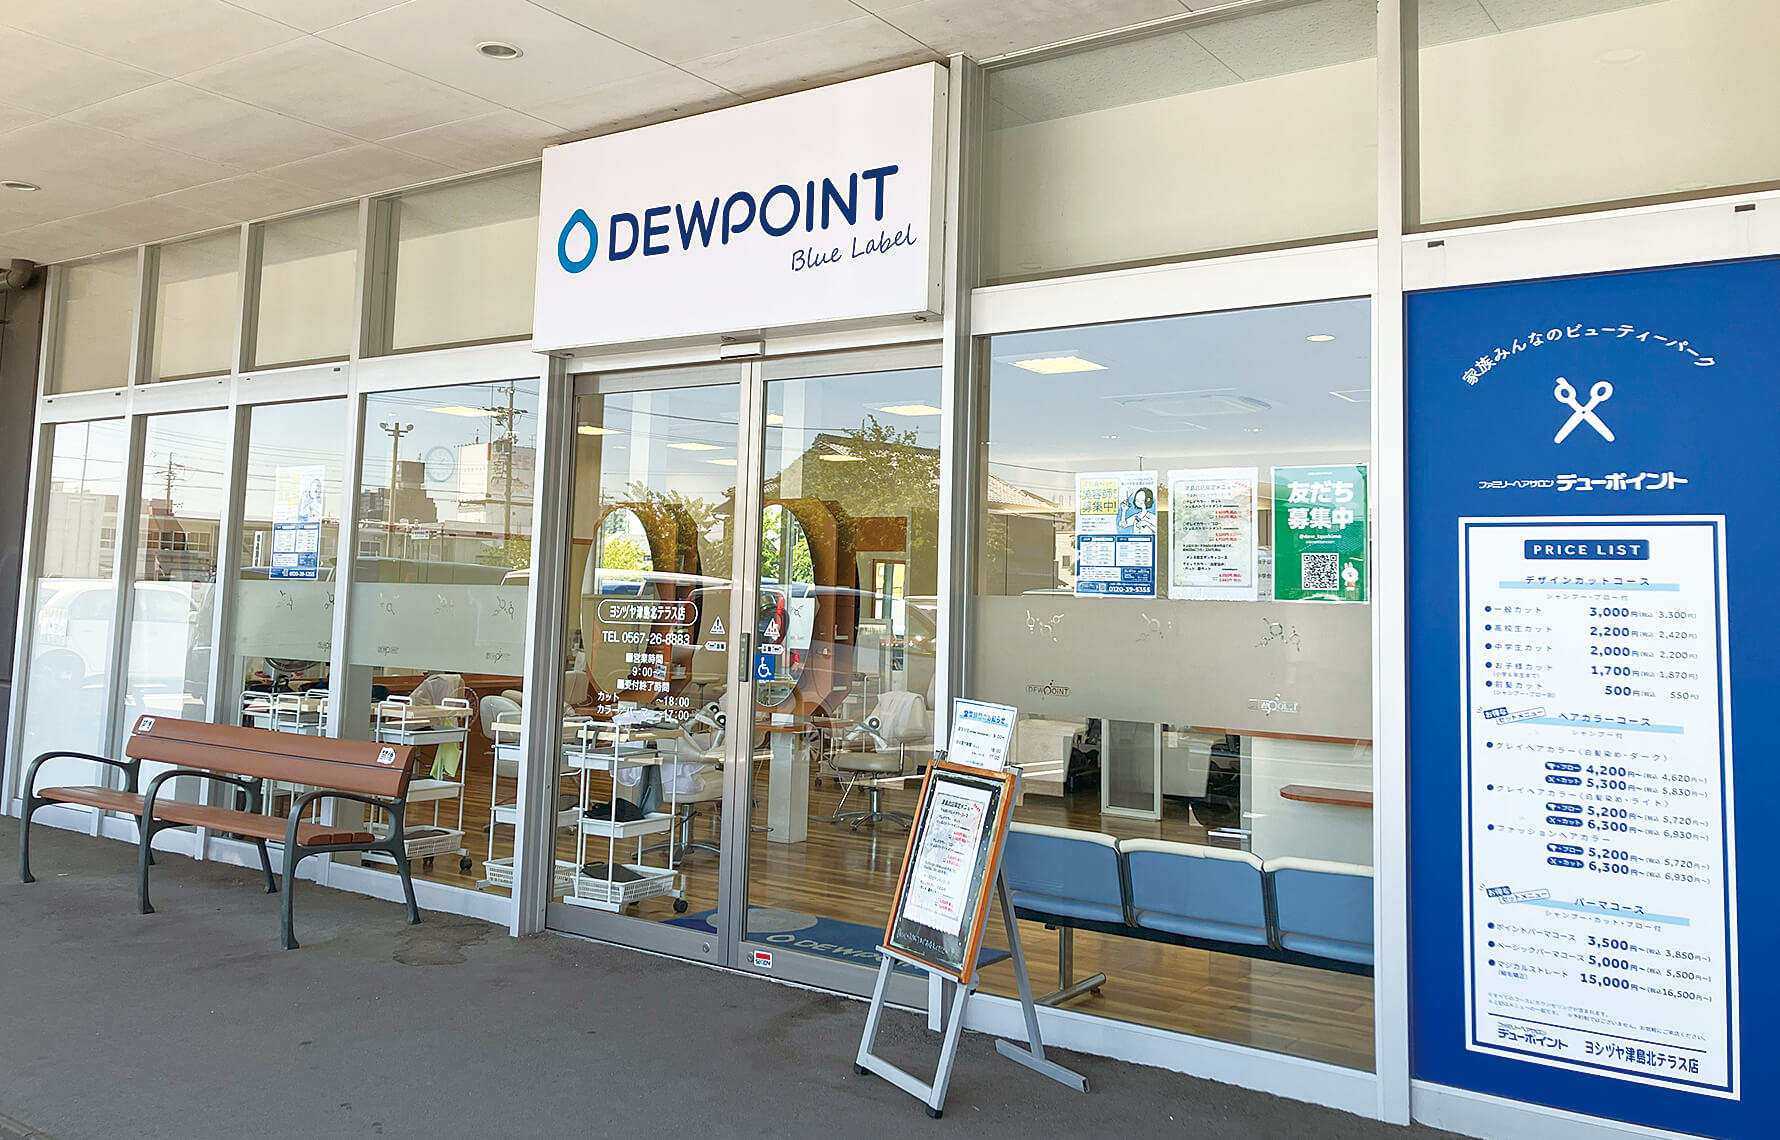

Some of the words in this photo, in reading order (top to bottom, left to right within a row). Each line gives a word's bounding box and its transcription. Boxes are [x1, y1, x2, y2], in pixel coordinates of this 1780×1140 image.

[608, 164, 899, 262] DEWPOINT
[791, 244, 842, 272] Blue
[851, 223, 918, 259] Label
[1461, 324, 1716, 386] 家族みんなのビューティーパーク
[1556, 471, 1689, 492] デューポイント
[1287, 480, 1354, 503] 友だち
[1287, 507, 1354, 529] 募集中
[1533, 544, 1588, 556] PRICE
[1597, 544, 1641, 556] LIST
[1526, 576, 1650, 586] デザインカットコース
[609, 605, 686, 621] ヨシヅヤ津島北テラス店
[602, 630, 619, 643] TEL
[621, 631, 690, 646] 0567-26-8883
[597, 691, 620, 702] カット
[1559, 713, 1651, 726] ヘアカラーコース
[1575, 898, 1644, 914] パーマコース
[1498, 1028, 1569, 1050] デューポイント
[1585, 1040, 1699, 1074] ヨシヅヤ津島北テラス店
